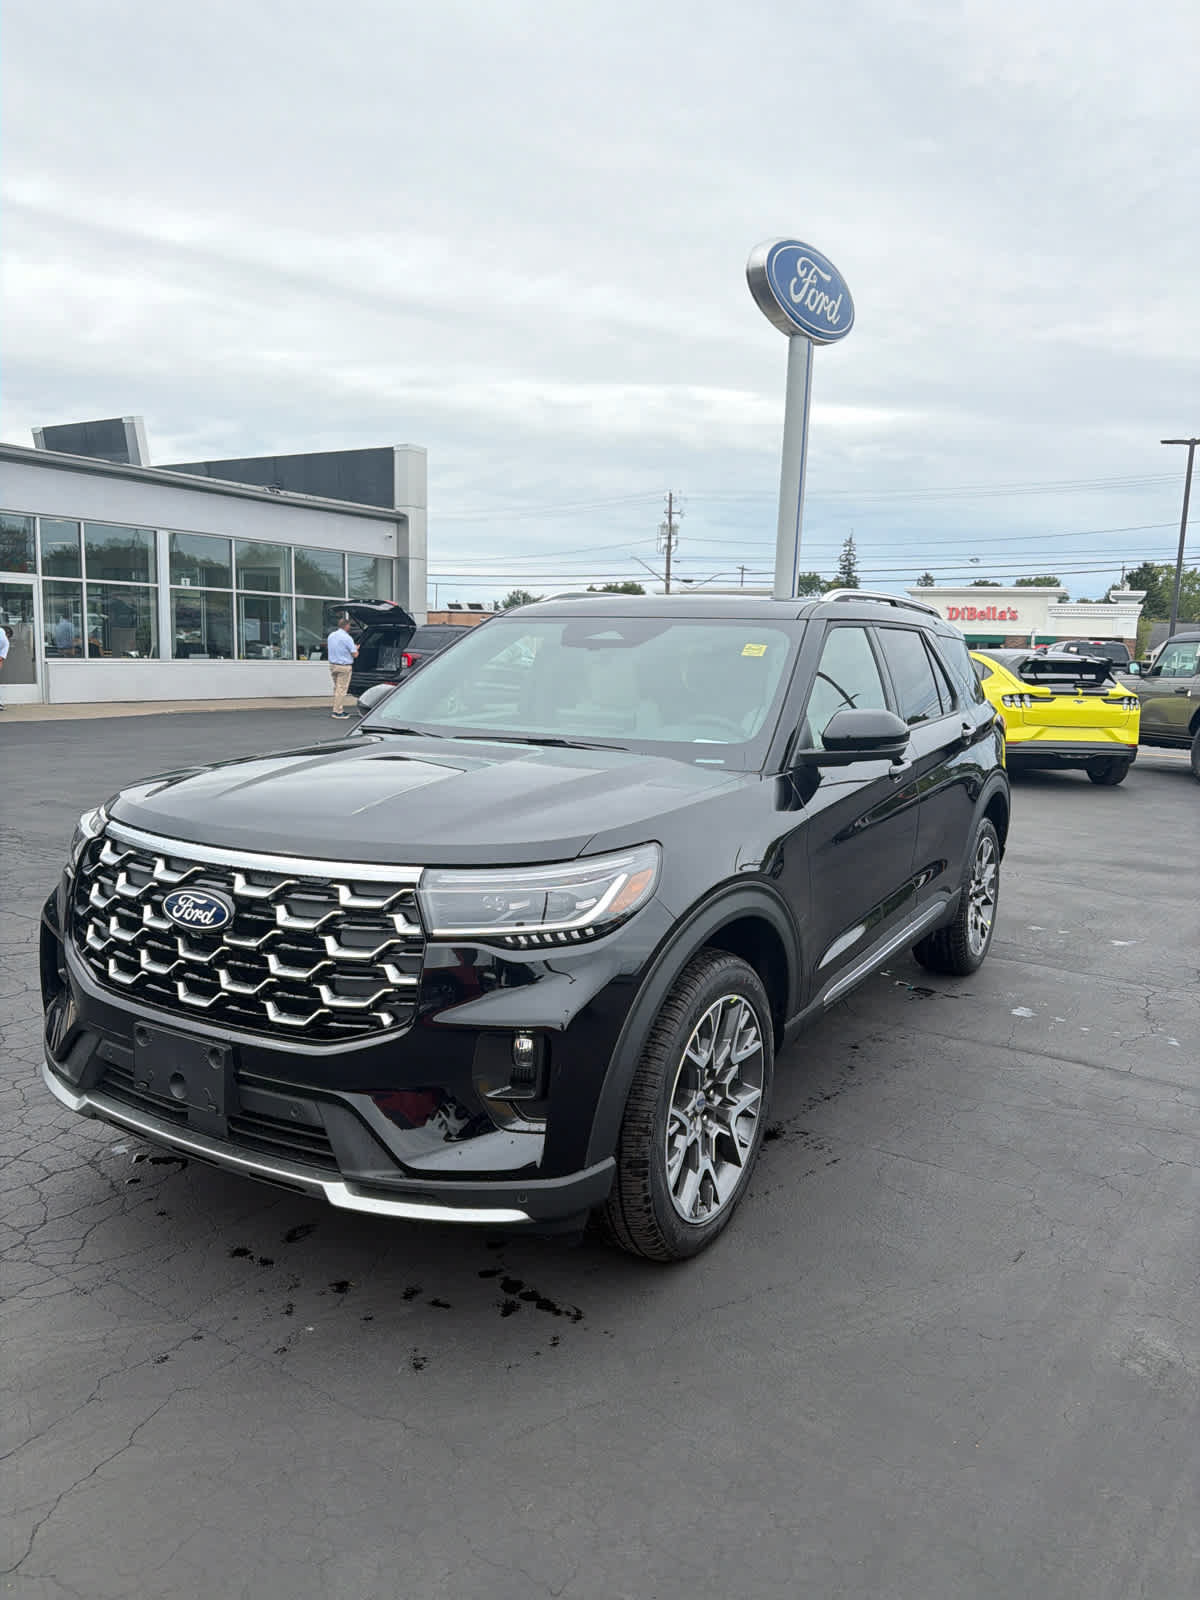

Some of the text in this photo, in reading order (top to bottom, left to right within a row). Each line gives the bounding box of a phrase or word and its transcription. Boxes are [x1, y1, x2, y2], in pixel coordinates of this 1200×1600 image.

[790, 256, 842, 324] Ford
[946, 606, 1018, 621] DiBella's
[172, 895, 217, 925] Ford
